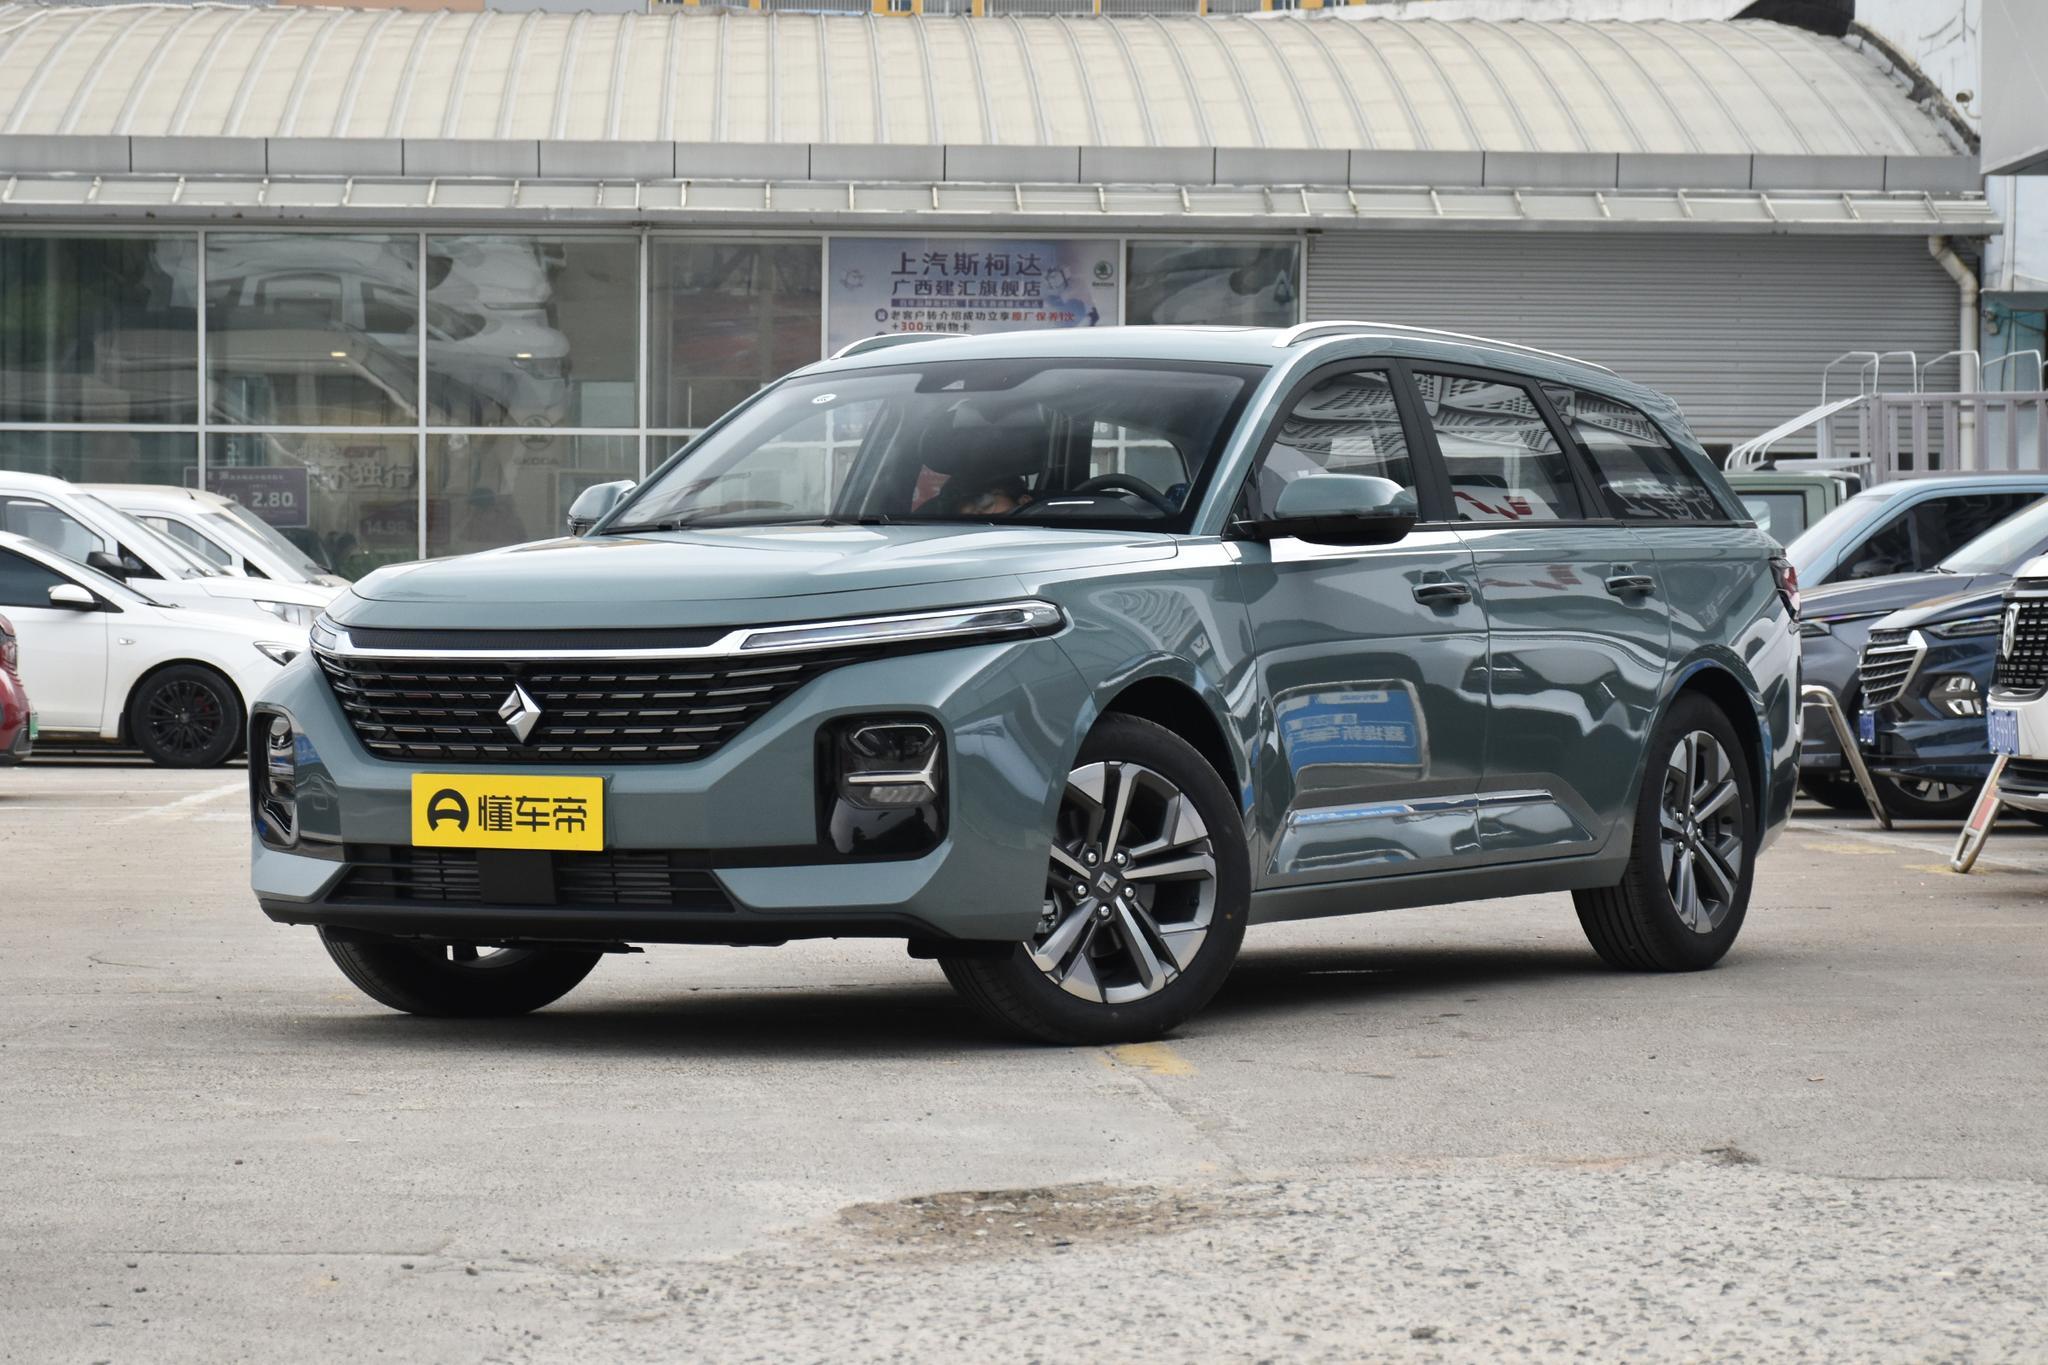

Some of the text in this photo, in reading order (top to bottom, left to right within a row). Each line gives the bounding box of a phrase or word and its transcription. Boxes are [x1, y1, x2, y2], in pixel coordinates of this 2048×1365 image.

[891, 251, 1042, 277] 上汽斯柯达
[891, 279, 1041, 297] 广西建汇旗舰店
[251, 491, 294, 508] 2.80
[478, 794, 587, 834] 懂车帝
